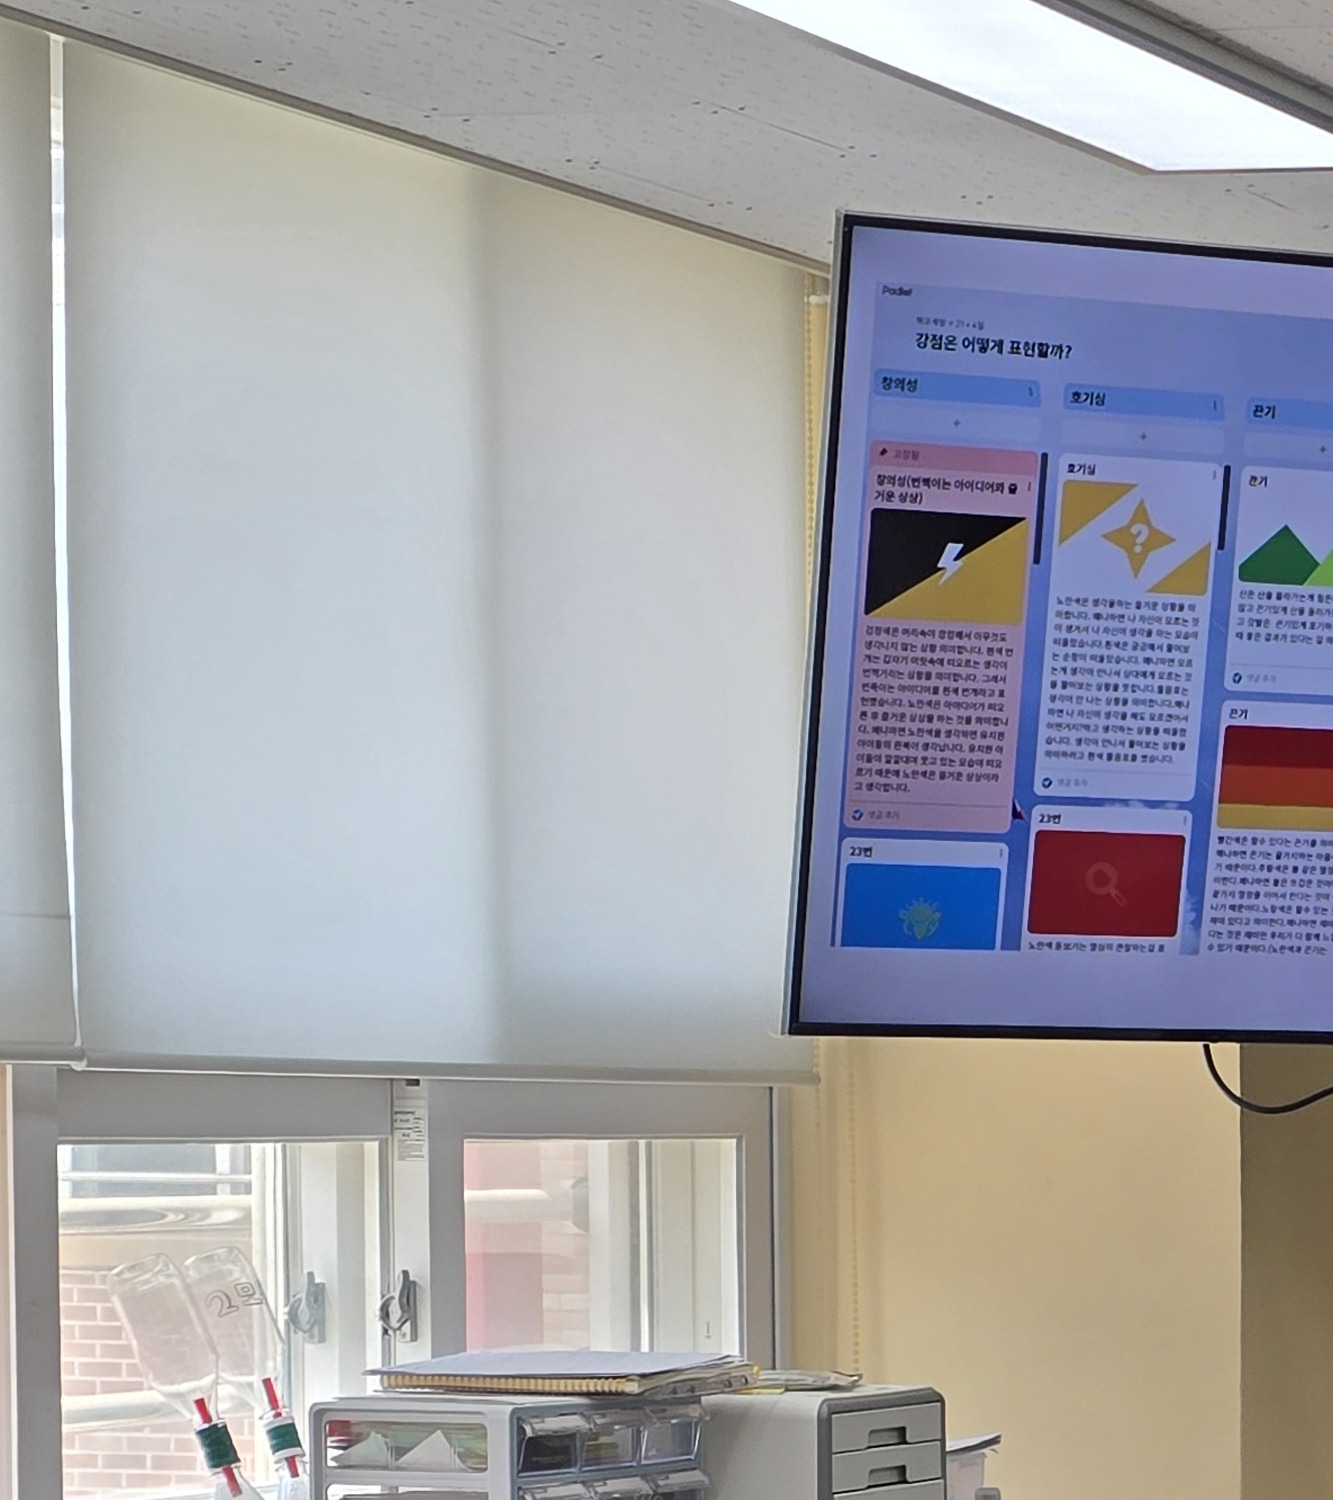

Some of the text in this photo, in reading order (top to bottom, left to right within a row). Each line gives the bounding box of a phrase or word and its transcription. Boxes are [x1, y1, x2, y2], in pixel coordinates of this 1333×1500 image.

[916, 333, 1072, 360] 강점은 어떻게 표현할까?
[881, 377, 918, 392] 창의성
[1070, 391, 1106, 406] 호기심
[1253, 405, 1276, 419] 끈기
[1067, 463, 1097, 476] 호기심
[954, 479, 1005, 494] 아이디어와
[1249, 475, 1268, 488] 끈기
[874, 490, 924, 504] 거운 상상)
[1228, 708, 1249, 720] 끈기
[1038, 813, 1061, 825] 23번
[849, 846, 873, 858] 23번
